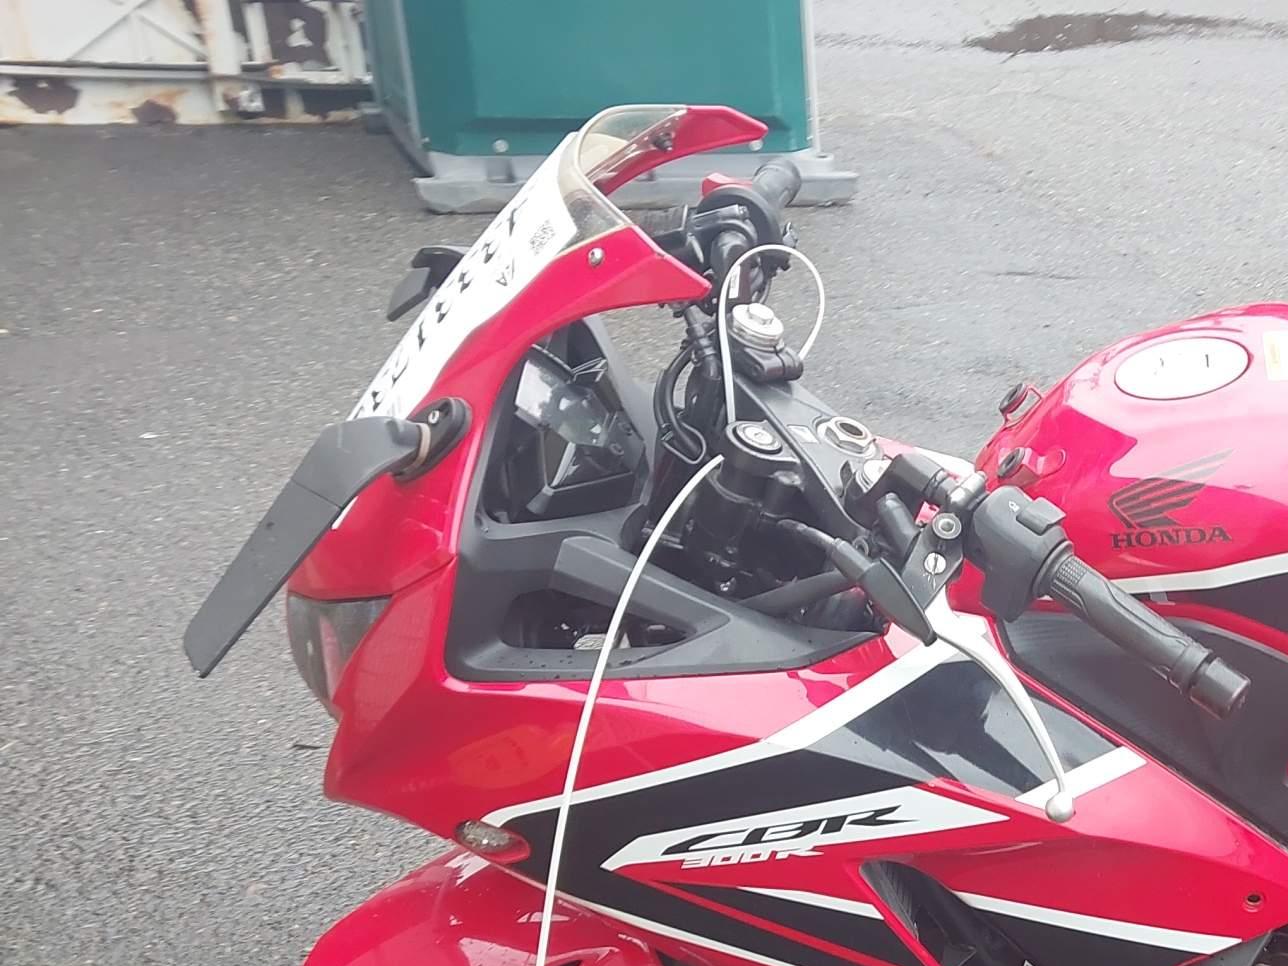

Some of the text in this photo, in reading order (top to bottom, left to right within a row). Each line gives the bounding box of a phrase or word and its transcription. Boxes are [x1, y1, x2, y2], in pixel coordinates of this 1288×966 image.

[1111, 526, 1232, 548] HONDA
[661, 805, 920, 856] CBR
[681, 848, 824, 869] 300R
